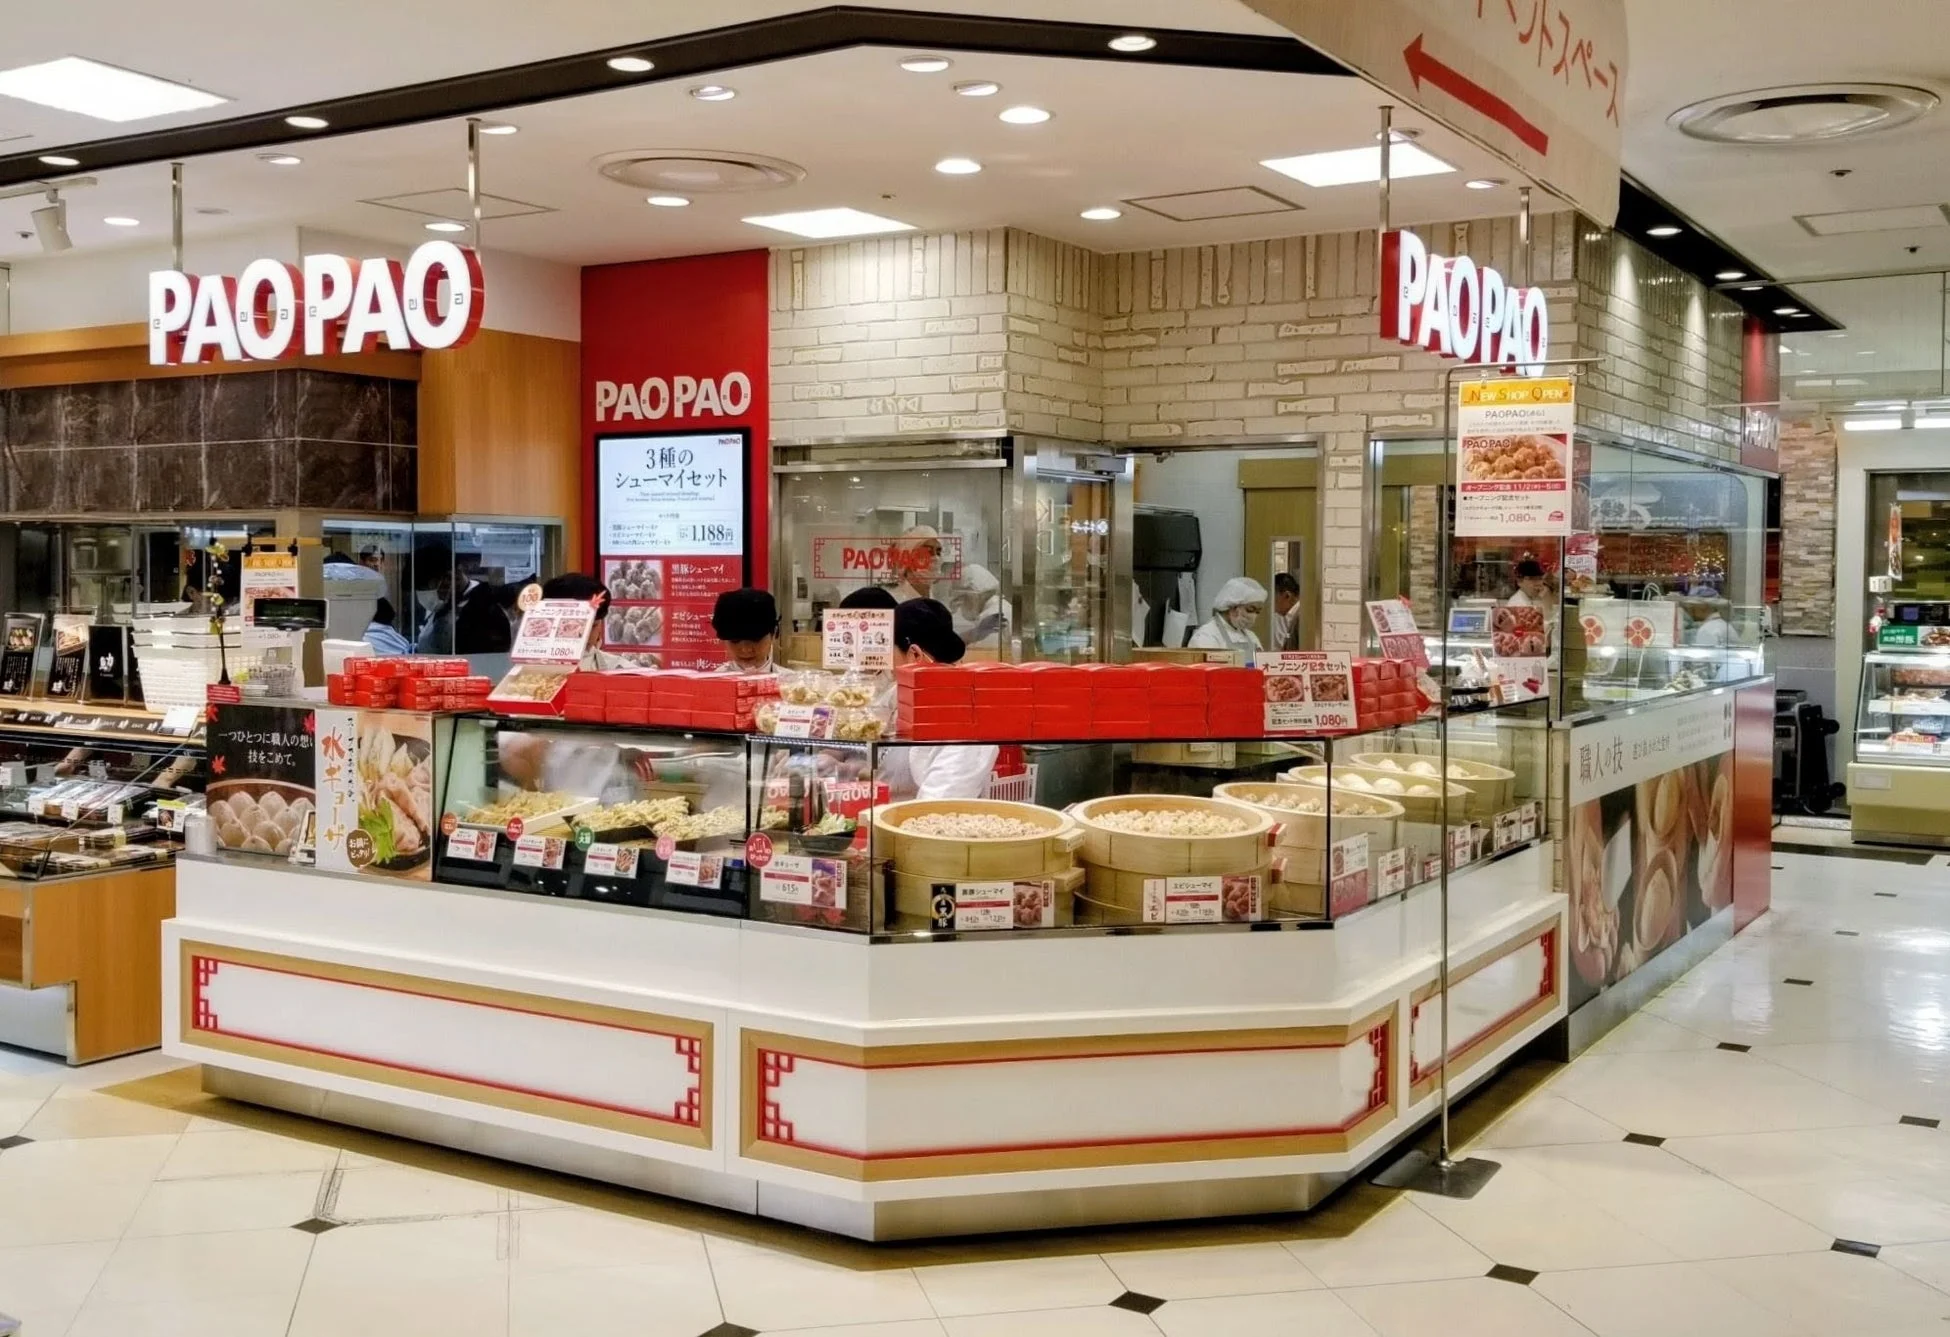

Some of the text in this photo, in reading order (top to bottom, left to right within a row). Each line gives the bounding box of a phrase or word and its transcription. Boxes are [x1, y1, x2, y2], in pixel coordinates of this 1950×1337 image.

[149, 241, 480, 365] PAOPAO
[1398, 229, 1548, 377] PAOPAO
[596, 371, 752, 422] PAOPAO
[1531, 386, 1563, 401] OPEN
[646, 446, 694, 470] 3種の
[615, 468, 728, 489] シューマイセット
[692, 523, 734, 542] 1,188円
[842, 547, 932, 571] PAOPAO
[1262, 661, 1347, 673] オープニング記念セット
[1314, 714, 1348, 726] 1,080円
[248, 748, 297, 767] 技をこめて。
[1578, 735, 1624, 786] 職人の技
[321, 726, 347, 851] 水ギョーザ
